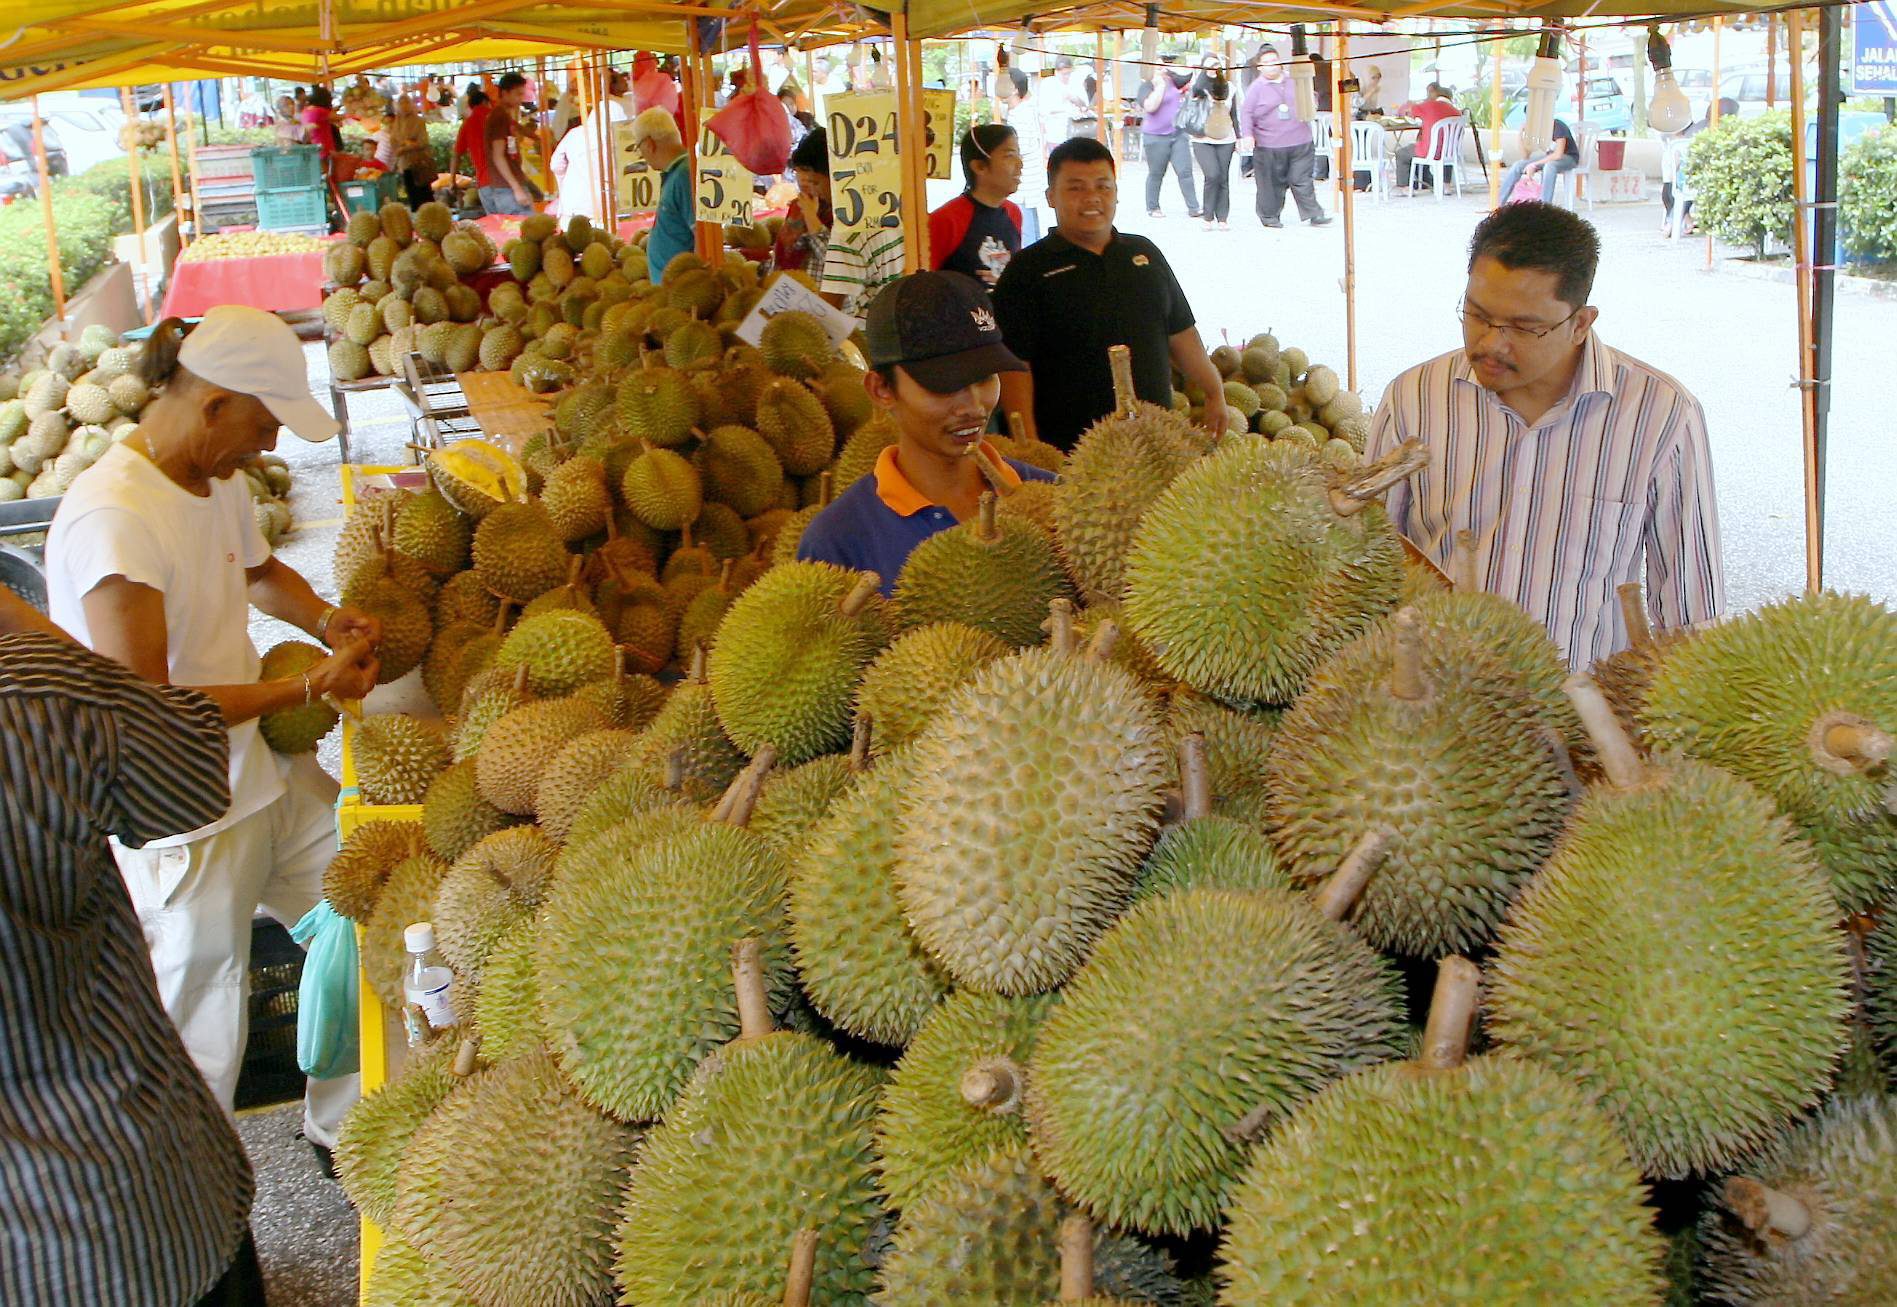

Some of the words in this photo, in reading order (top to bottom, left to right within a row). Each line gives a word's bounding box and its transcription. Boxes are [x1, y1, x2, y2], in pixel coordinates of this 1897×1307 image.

[1861, 47, 1897, 63] JALA
[631, 176, 653, 207] 10
[700, 169, 724, 209] 5
[833, 170, 864, 226] 3
[731, 200, 752, 227] 20
